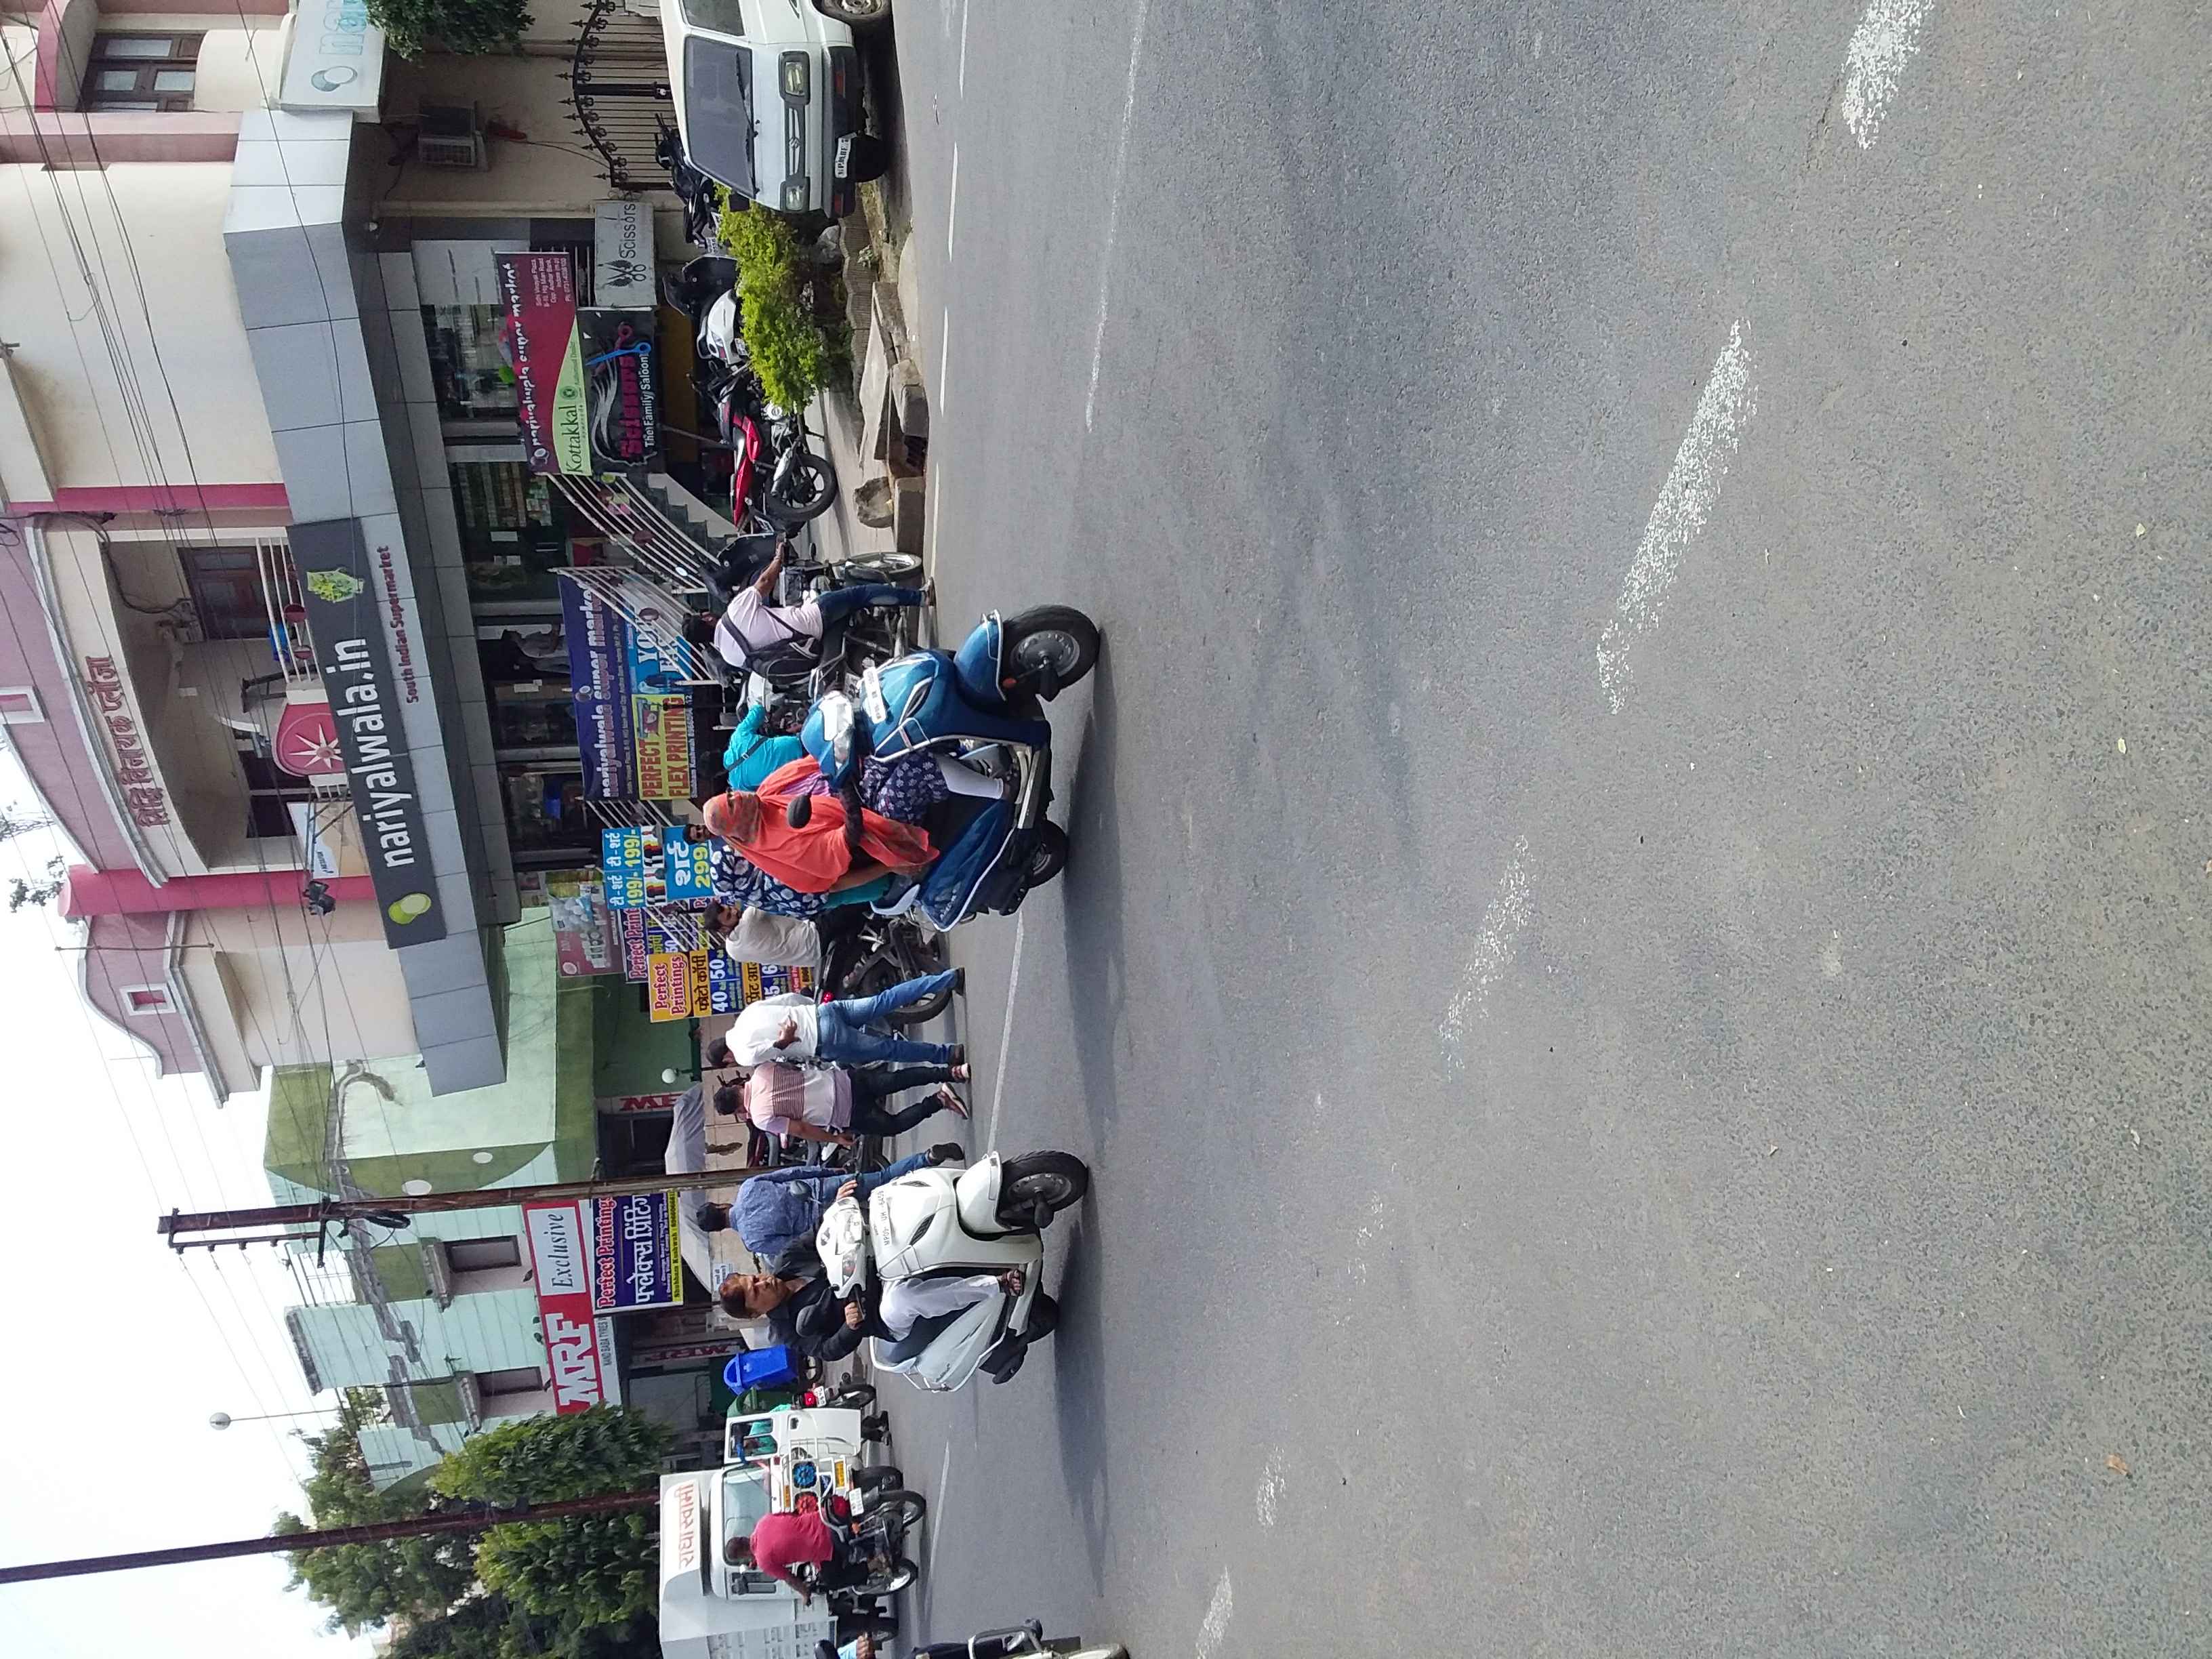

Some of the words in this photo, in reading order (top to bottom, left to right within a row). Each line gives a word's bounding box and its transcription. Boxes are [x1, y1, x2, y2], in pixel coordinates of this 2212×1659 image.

[619, 204, 636, 259] Scissors
[639, 356, 651, 390] Saloon
[641, 394, 655, 426] Family
[558, 405, 583, 473] Kottakkal
[644, 430, 655, 447] The
[377, 546, 404, 628] Supermarket
[395, 630, 411, 666] Indian
[401, 668, 419, 703] South
[589, 651, 613, 700] super
[325, 638, 413, 867] nariyalwala.in
[591, 705, 622, 797] nariyalwala
[663, 697, 687, 762] PRINTING
[638, 739, 663, 797] PERFECT
[667, 764, 689, 797] FLEX
[623, 830, 641, 867] 199/-
[667, 840, 691, 886] शर्ट
[625, 872, 643, 906] 199/-
[624, 907, 644, 938] Print
[628, 939, 647, 978] Perfect
[691, 955, 708, 983] कॉपी
[710, 960, 725, 979] 50
[653, 964, 670, 1010] Perfect
[670, 956, 687, 1015] Printings
[693, 984, 709, 1011] फोटो
[712, 991, 729, 1012] 40
[544, 1214, 573, 1287] Exclusive
[626, 1240, 654, 1303] फ्लेक्स
[596, 1257, 615, 1307] Perfect
[546, 1312, 599, 1406] MRF
